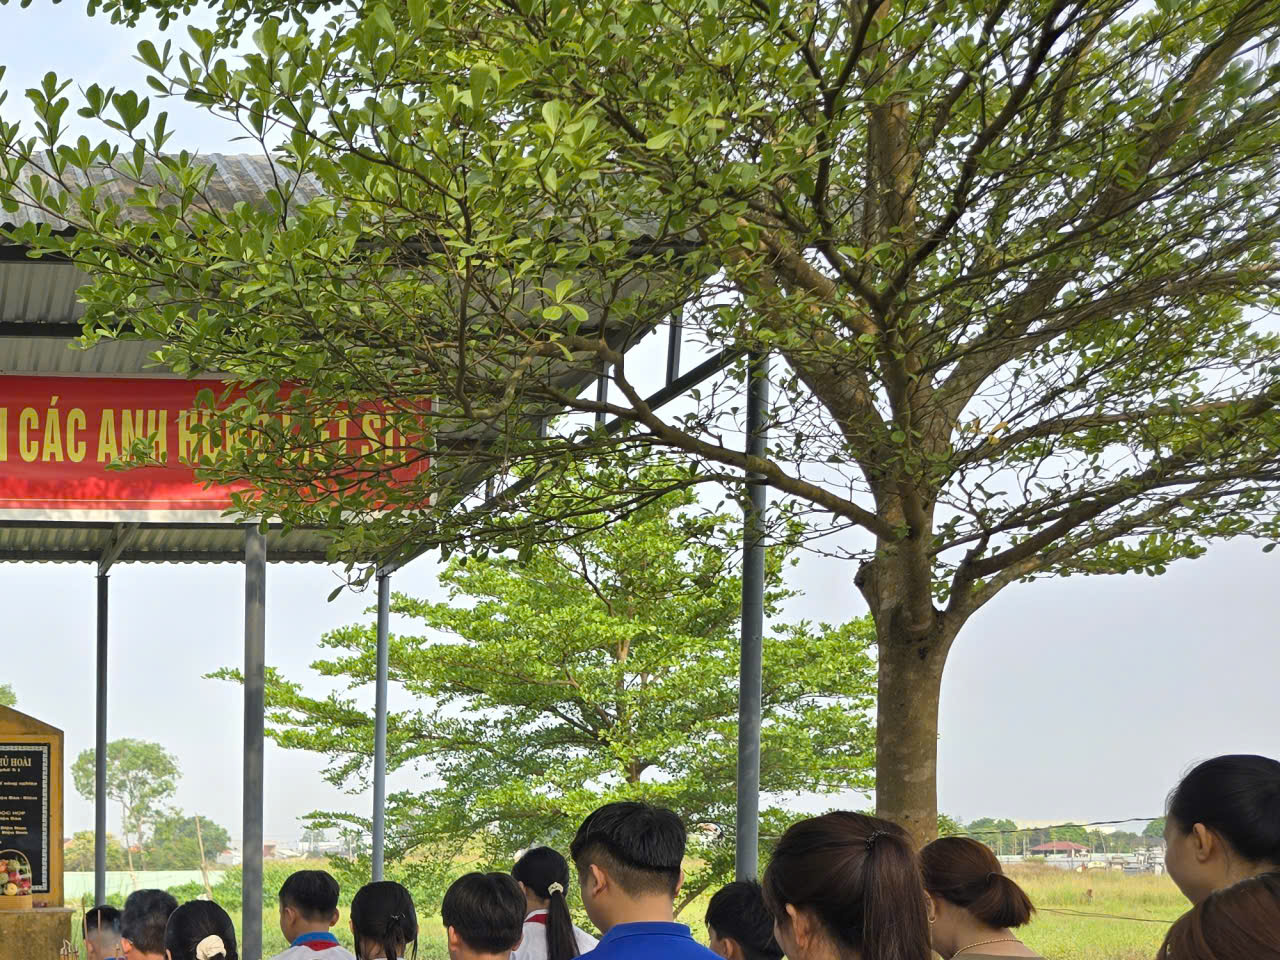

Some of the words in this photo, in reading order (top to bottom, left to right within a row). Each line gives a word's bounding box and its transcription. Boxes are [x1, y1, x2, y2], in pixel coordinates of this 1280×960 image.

[20, 396, 86, 463] CÁC
[97, 409, 167, 463] ANH
[10, 756, 32, 767] HOÀI
